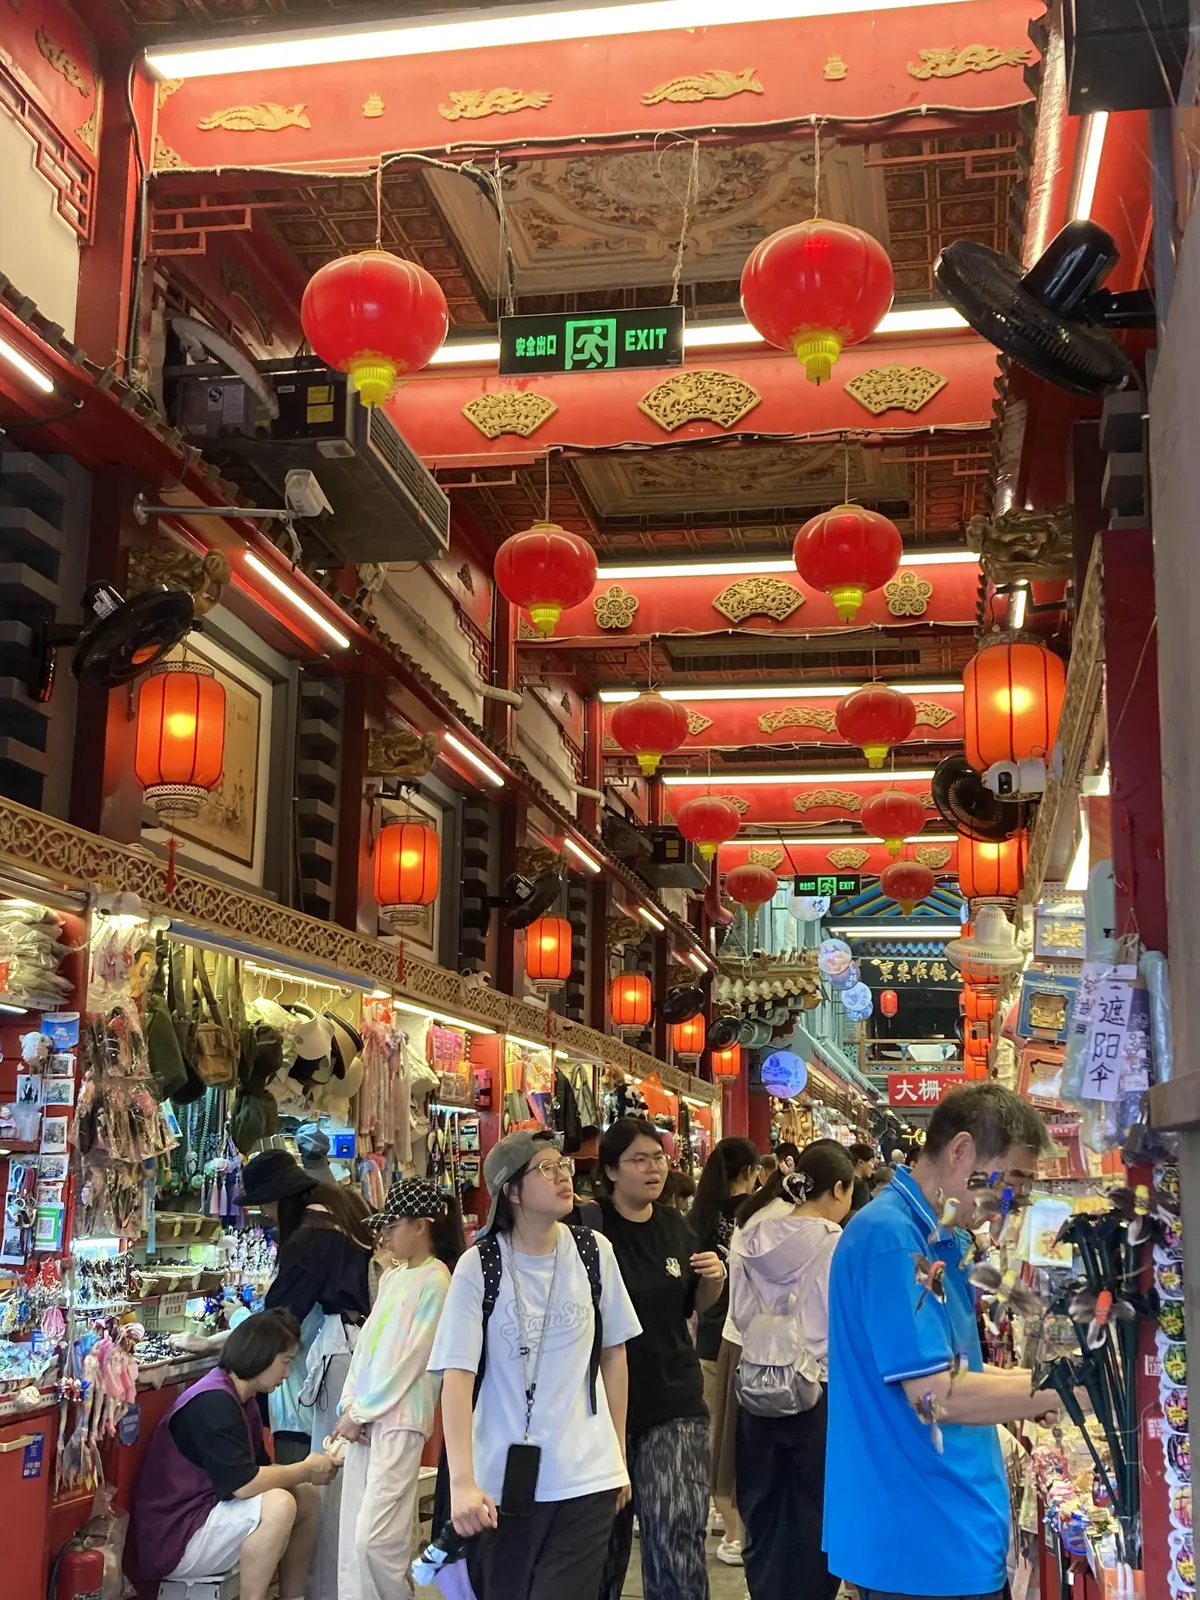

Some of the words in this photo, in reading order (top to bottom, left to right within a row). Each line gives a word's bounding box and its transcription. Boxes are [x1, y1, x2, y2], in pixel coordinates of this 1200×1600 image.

[515, 334, 557, 357] 安全出口
[625, 327, 668, 352] EXIT
[839, 881, 856, 890] EXIT
[1088, 995, 1126, 1093] 遮阳伞
